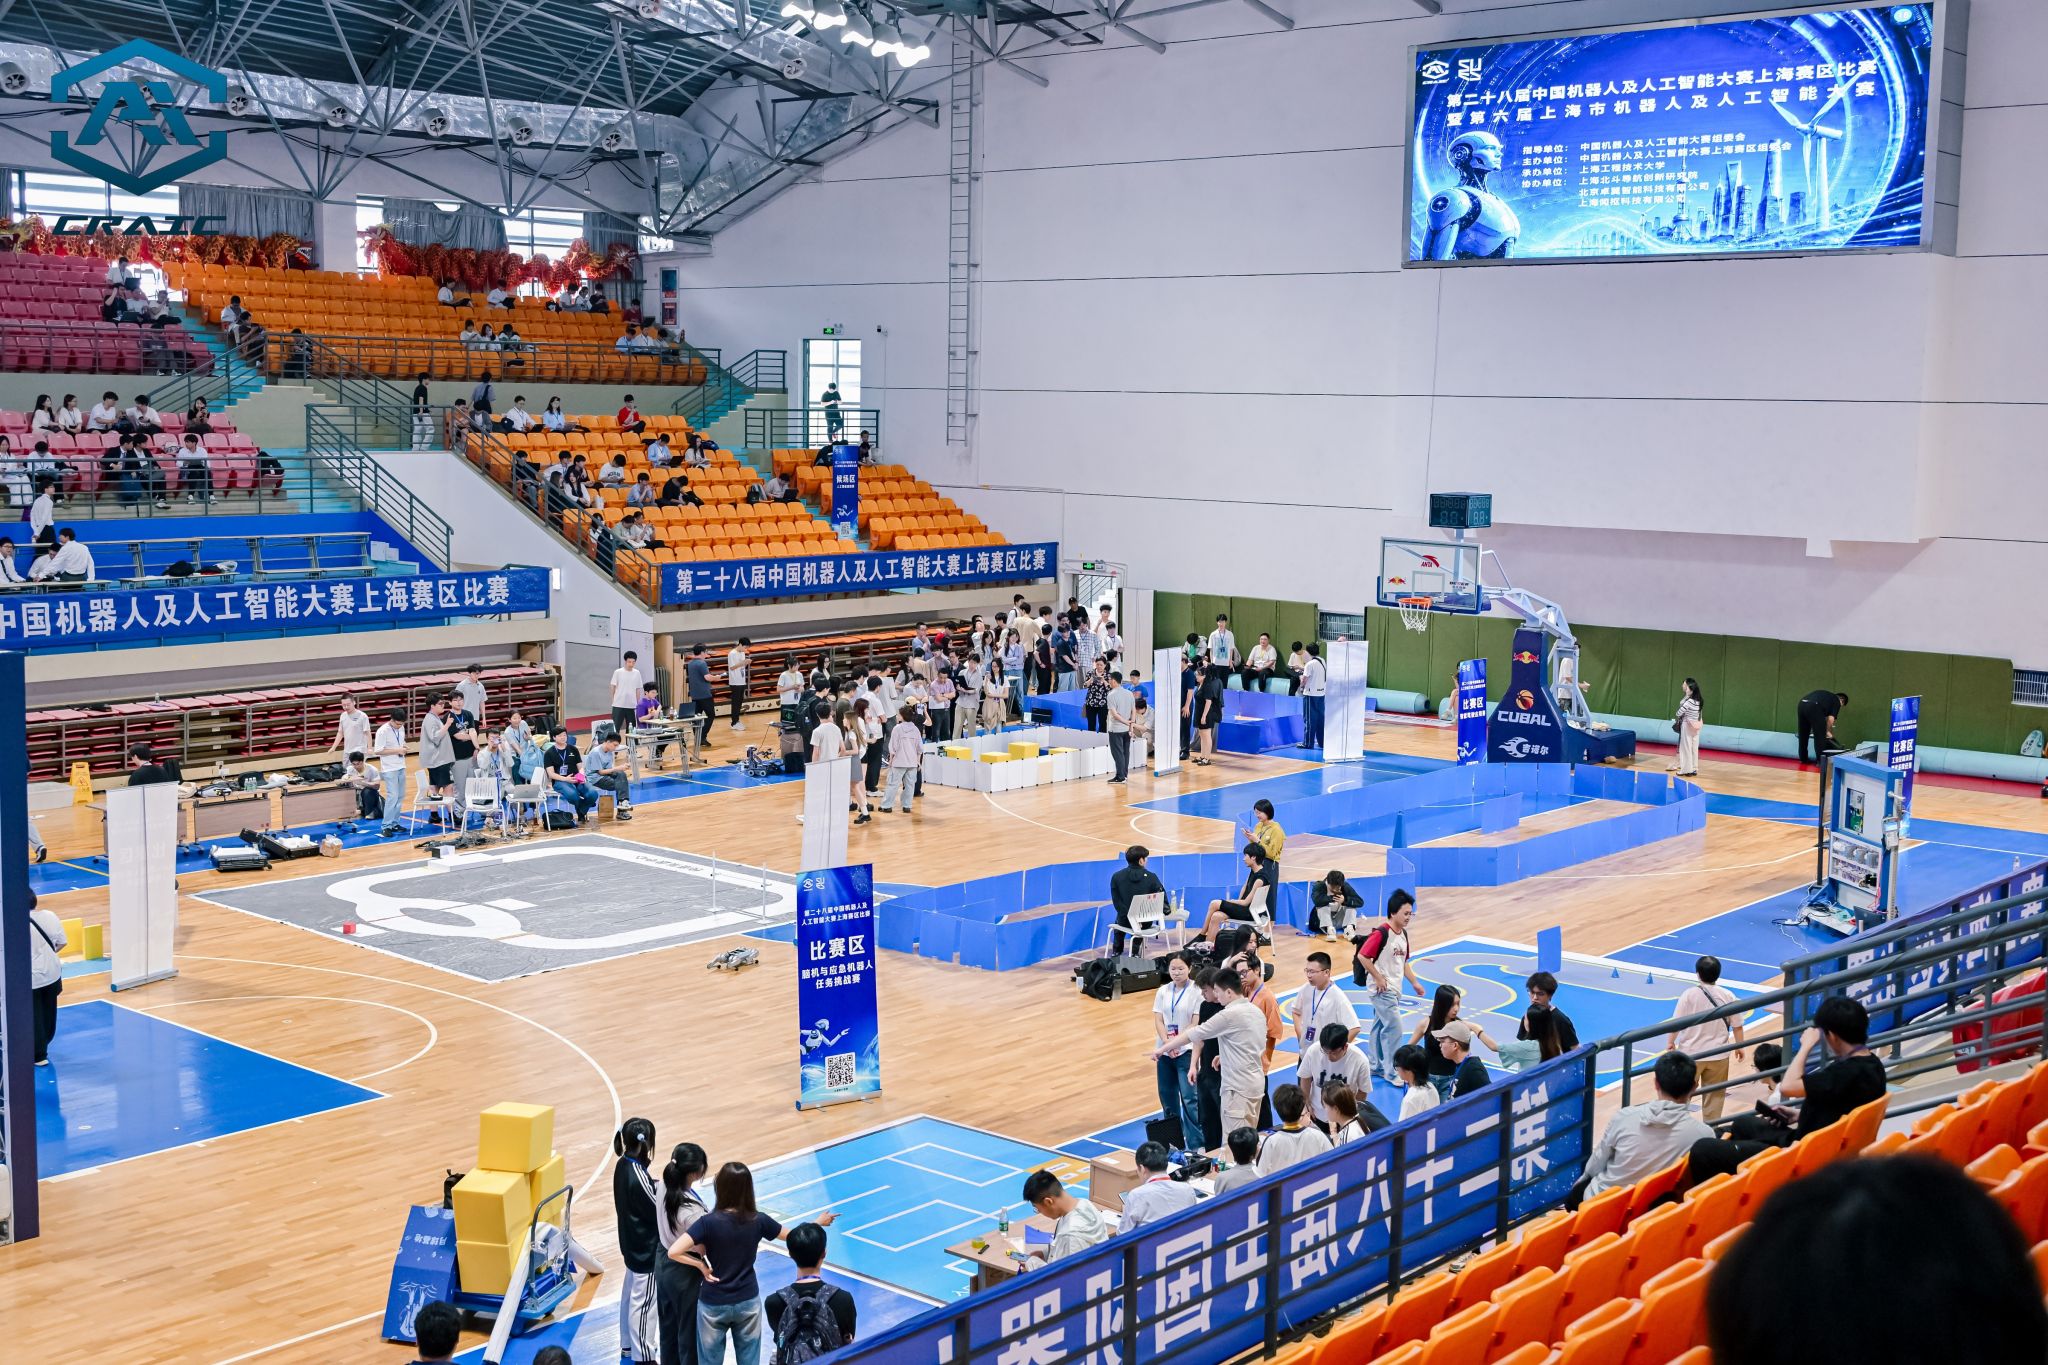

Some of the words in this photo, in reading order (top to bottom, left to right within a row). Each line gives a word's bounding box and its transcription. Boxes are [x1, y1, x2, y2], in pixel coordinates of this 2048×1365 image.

[1446, 60, 1878, 108] 第二十八届中国机器人及人工智能大赛上海赛区比赛
[1580, 132, 1746, 152] 中国机器人及人工智能大赛组委会
[1579, 161, 1666, 174] 上海工程技术大学
[1578, 171, 1698, 186] 上海北斗导航创新研究院
[676, 547, 1047, 596] 第二十八届中国机器人及人工智能大赛上海赛区比赛
[1463, 696, 1484, 710] 比赛区
[1497, 710, 1552, 727] CUBAL
[1893, 738, 1914, 754] 比赛区
[804, 902, 868, 917] 第二十八届中国机器人及
[801, 910, 871, 926] 人工智能大赛上海赛区比赛
[810, 934, 866, 961] 比赛区
[801, 959, 874, 980] 脑机与应急机器人
[815, 973, 861, 989] 任务挑战赛
